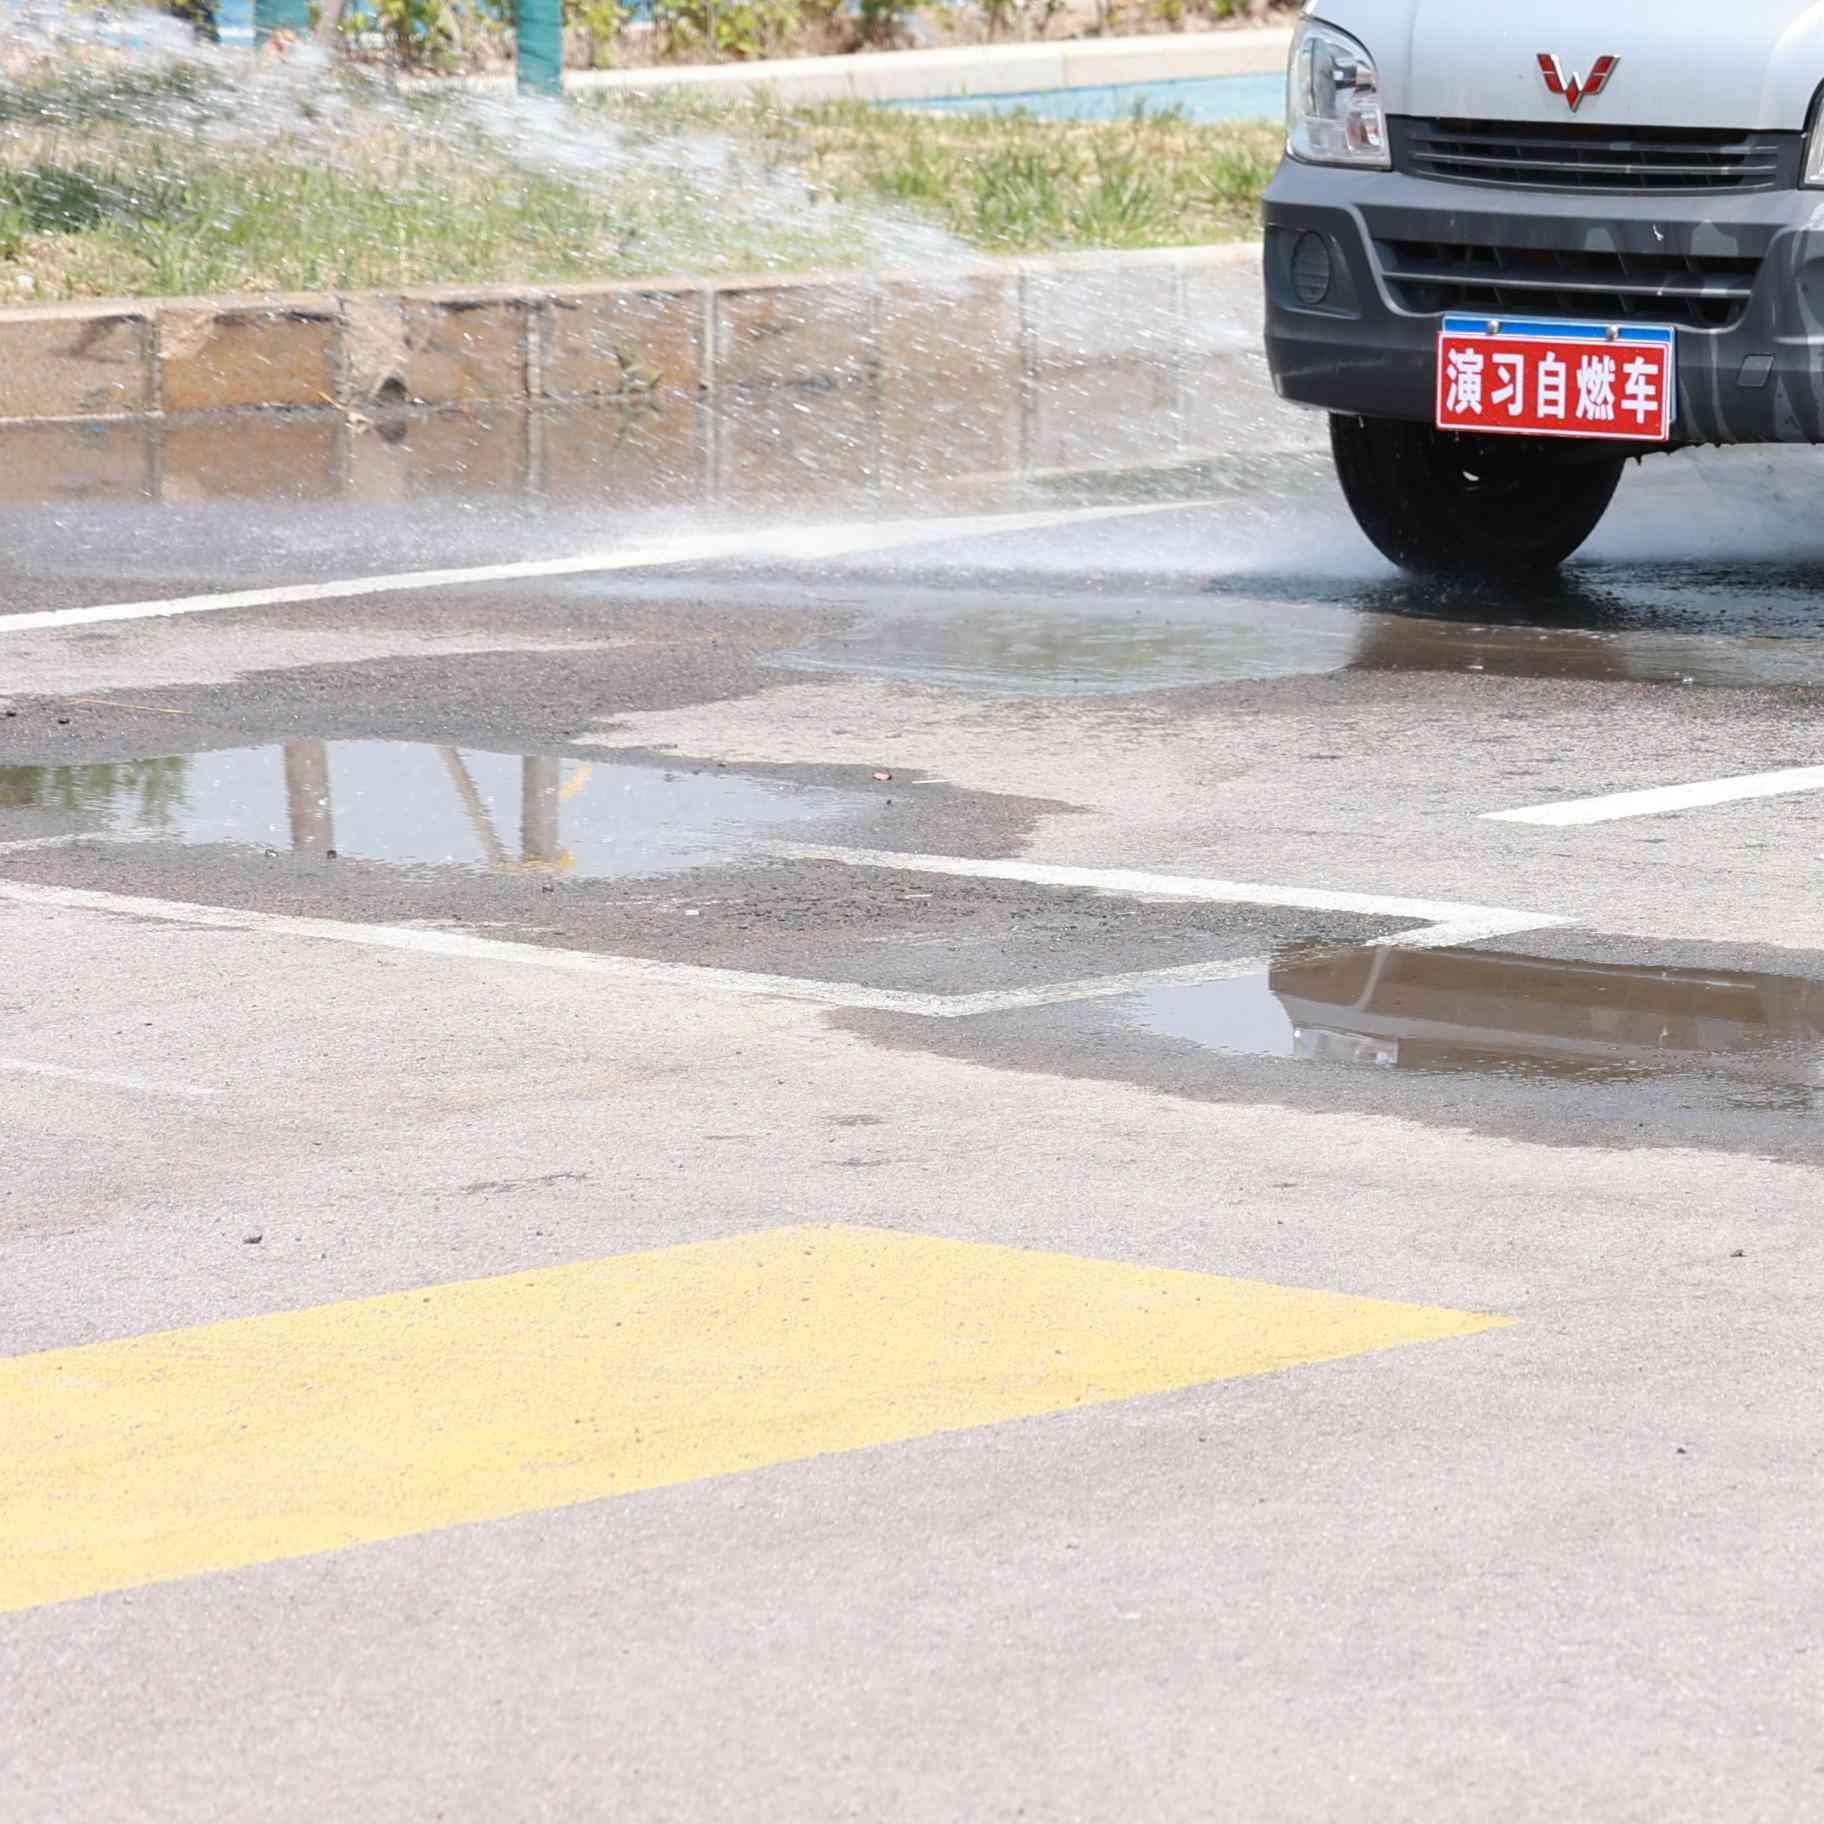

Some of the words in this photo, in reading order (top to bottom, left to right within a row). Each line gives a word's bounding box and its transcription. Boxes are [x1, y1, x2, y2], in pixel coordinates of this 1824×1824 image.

[1445, 347, 1660, 425] 演习自燃车
